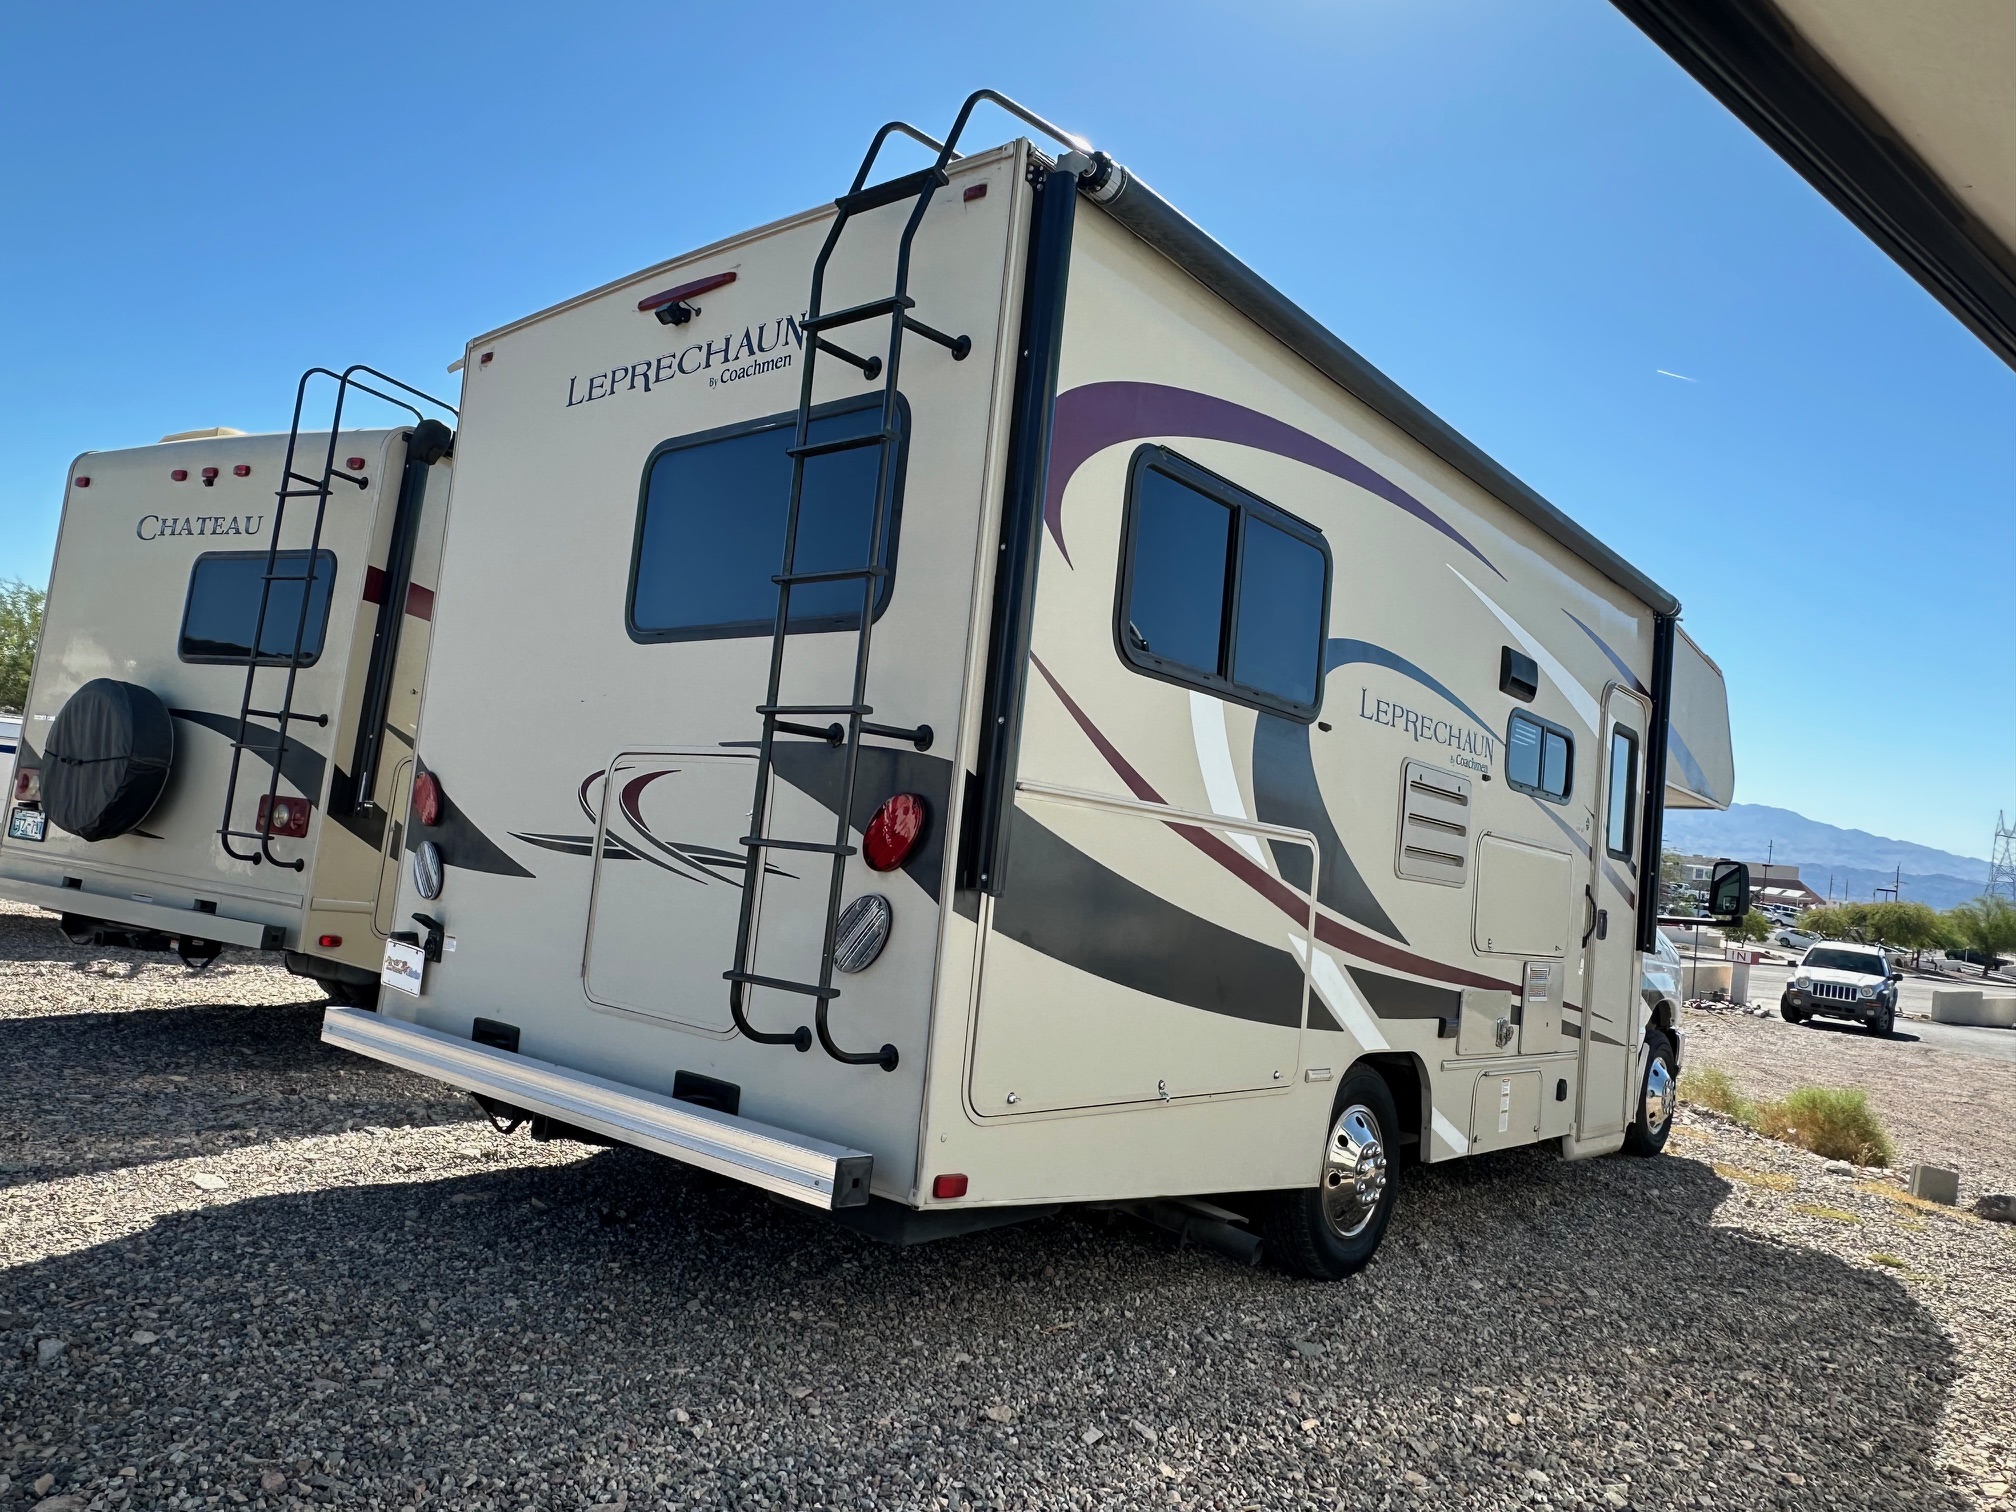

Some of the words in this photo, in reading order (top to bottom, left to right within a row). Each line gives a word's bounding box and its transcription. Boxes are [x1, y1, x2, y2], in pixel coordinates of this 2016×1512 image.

[566, 310, 807, 408] LEPRECHAUN
[709, 377, 718, 389] By
[720, 354, 792, 384] Coachmen
[136, 514, 264, 541] CHATEAU
[1359, 686, 1494, 766] LEPRECHAUN
[1732, 950, 1747, 962] IN
